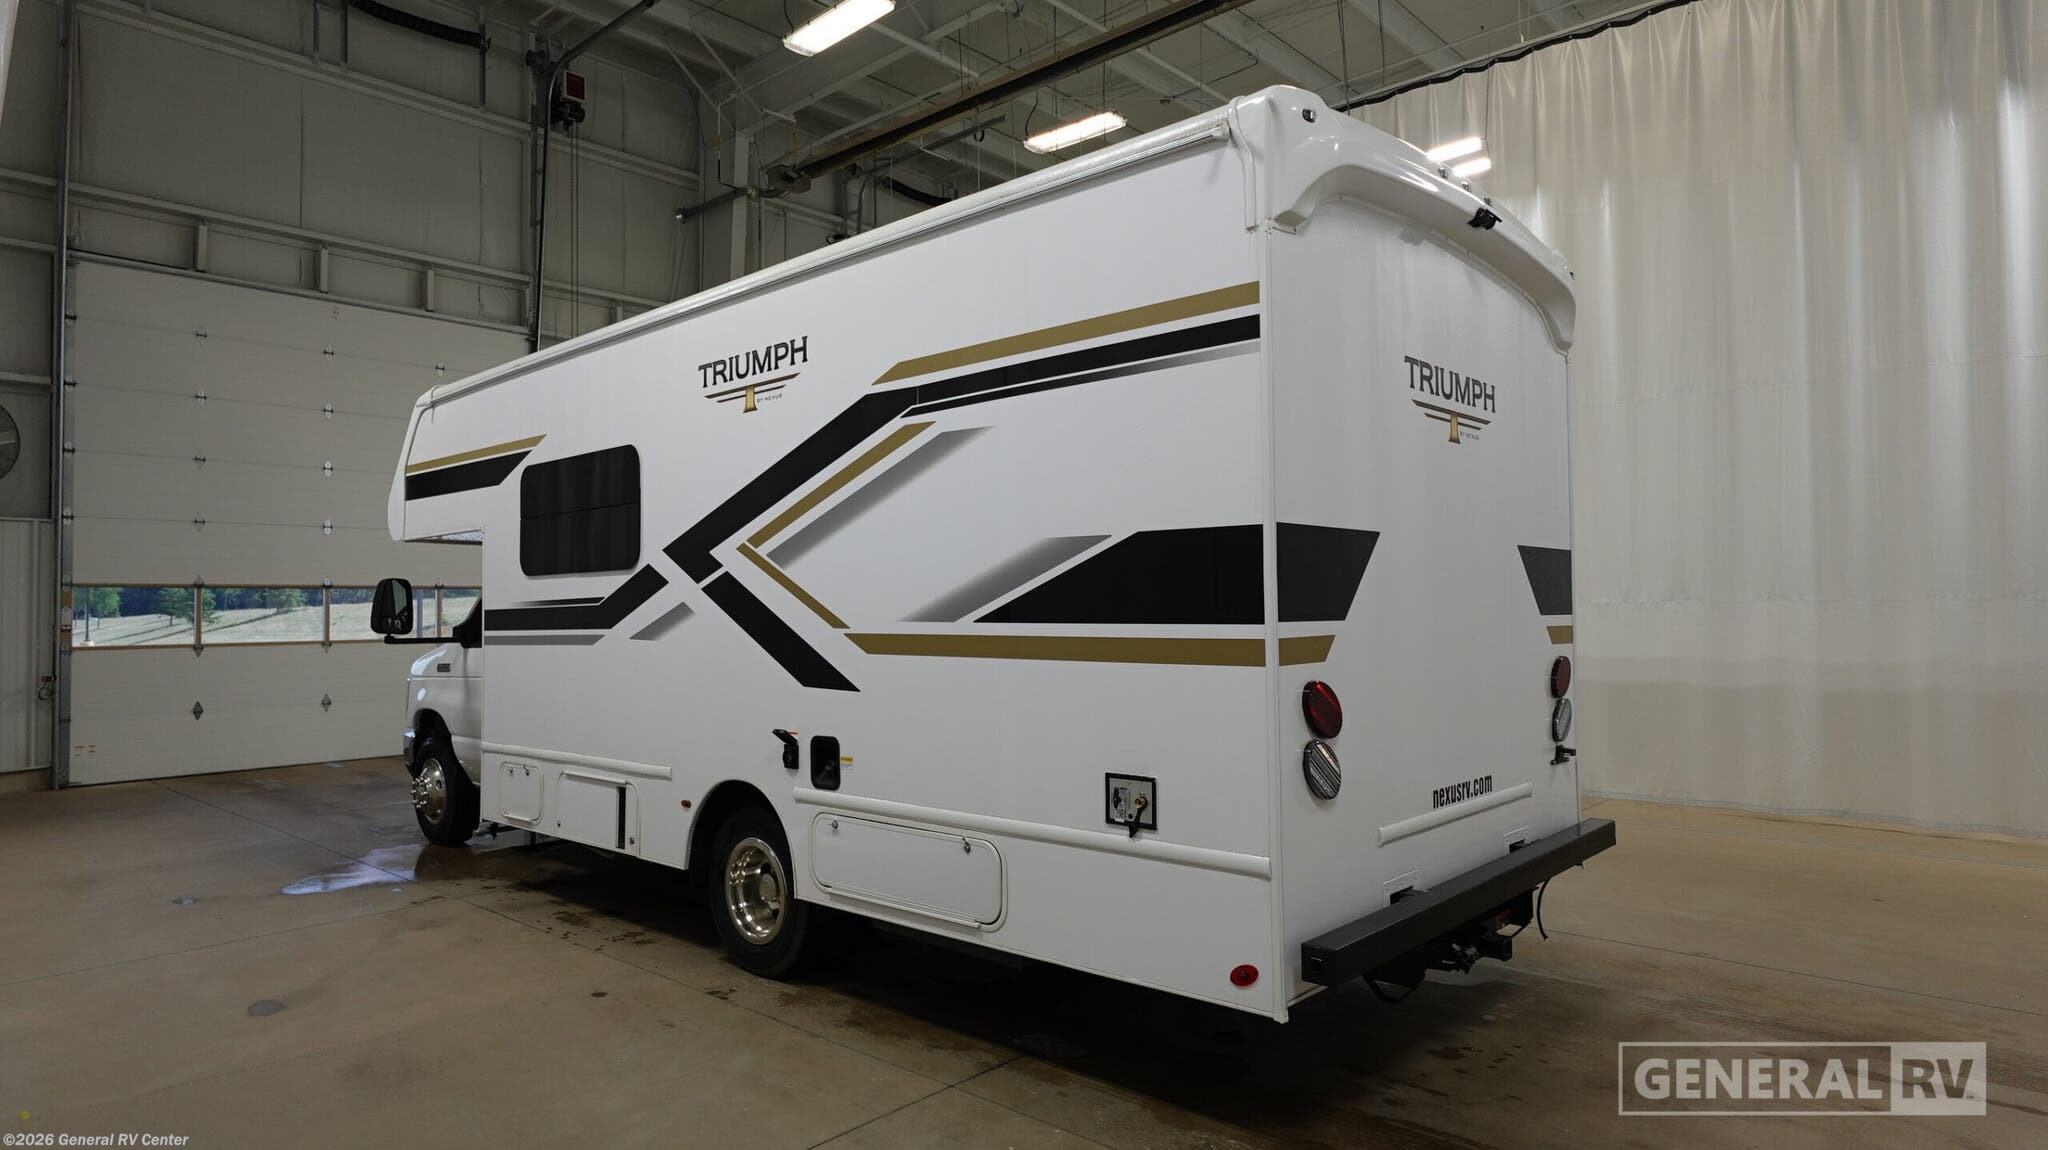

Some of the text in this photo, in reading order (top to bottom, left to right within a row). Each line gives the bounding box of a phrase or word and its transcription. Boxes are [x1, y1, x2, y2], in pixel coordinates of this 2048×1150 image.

[698, 335, 808, 388] TRIUMPH
[1404, 355, 1496, 413] TRIUMPH
[1432, 774, 1493, 809] nexusrv.com
